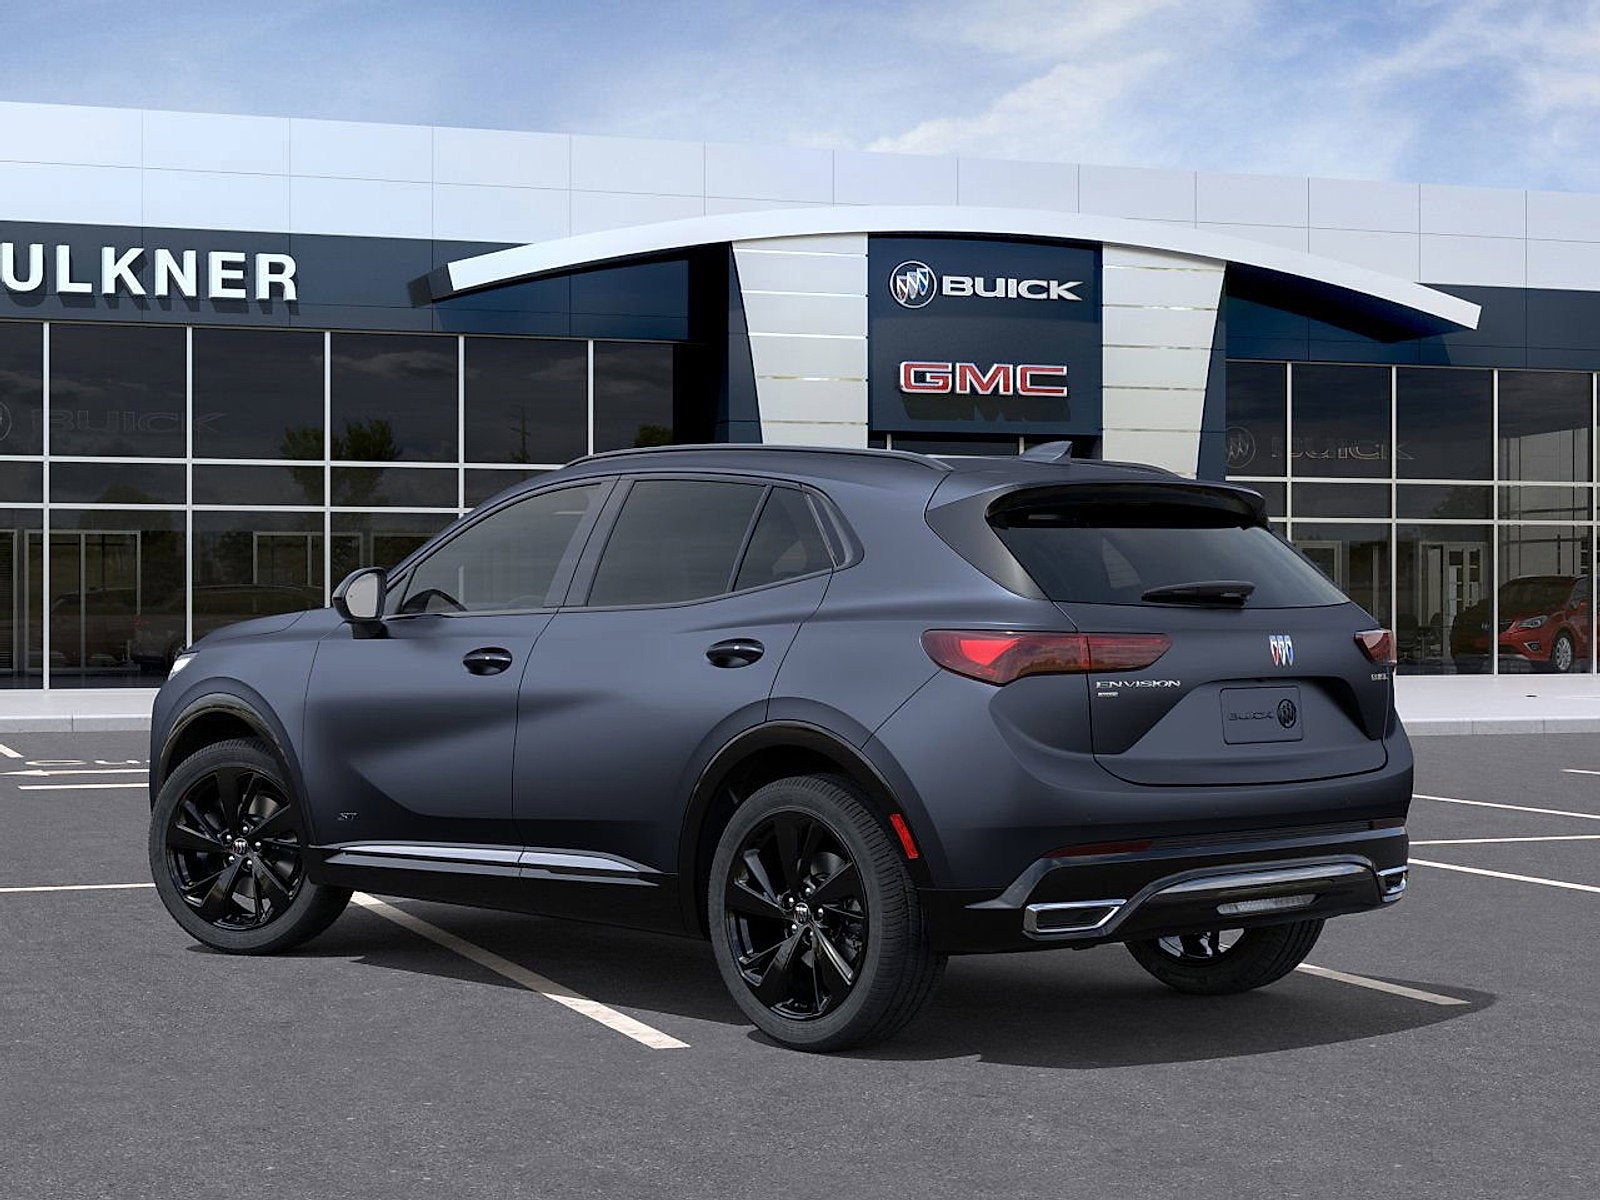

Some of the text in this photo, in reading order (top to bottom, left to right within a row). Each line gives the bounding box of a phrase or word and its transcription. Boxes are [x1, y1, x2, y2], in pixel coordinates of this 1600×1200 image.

[941, 275, 1084, 302] BUICK
[900, 360, 1069, 397] GMC
[1095, 680, 1181, 689] ENVISION
